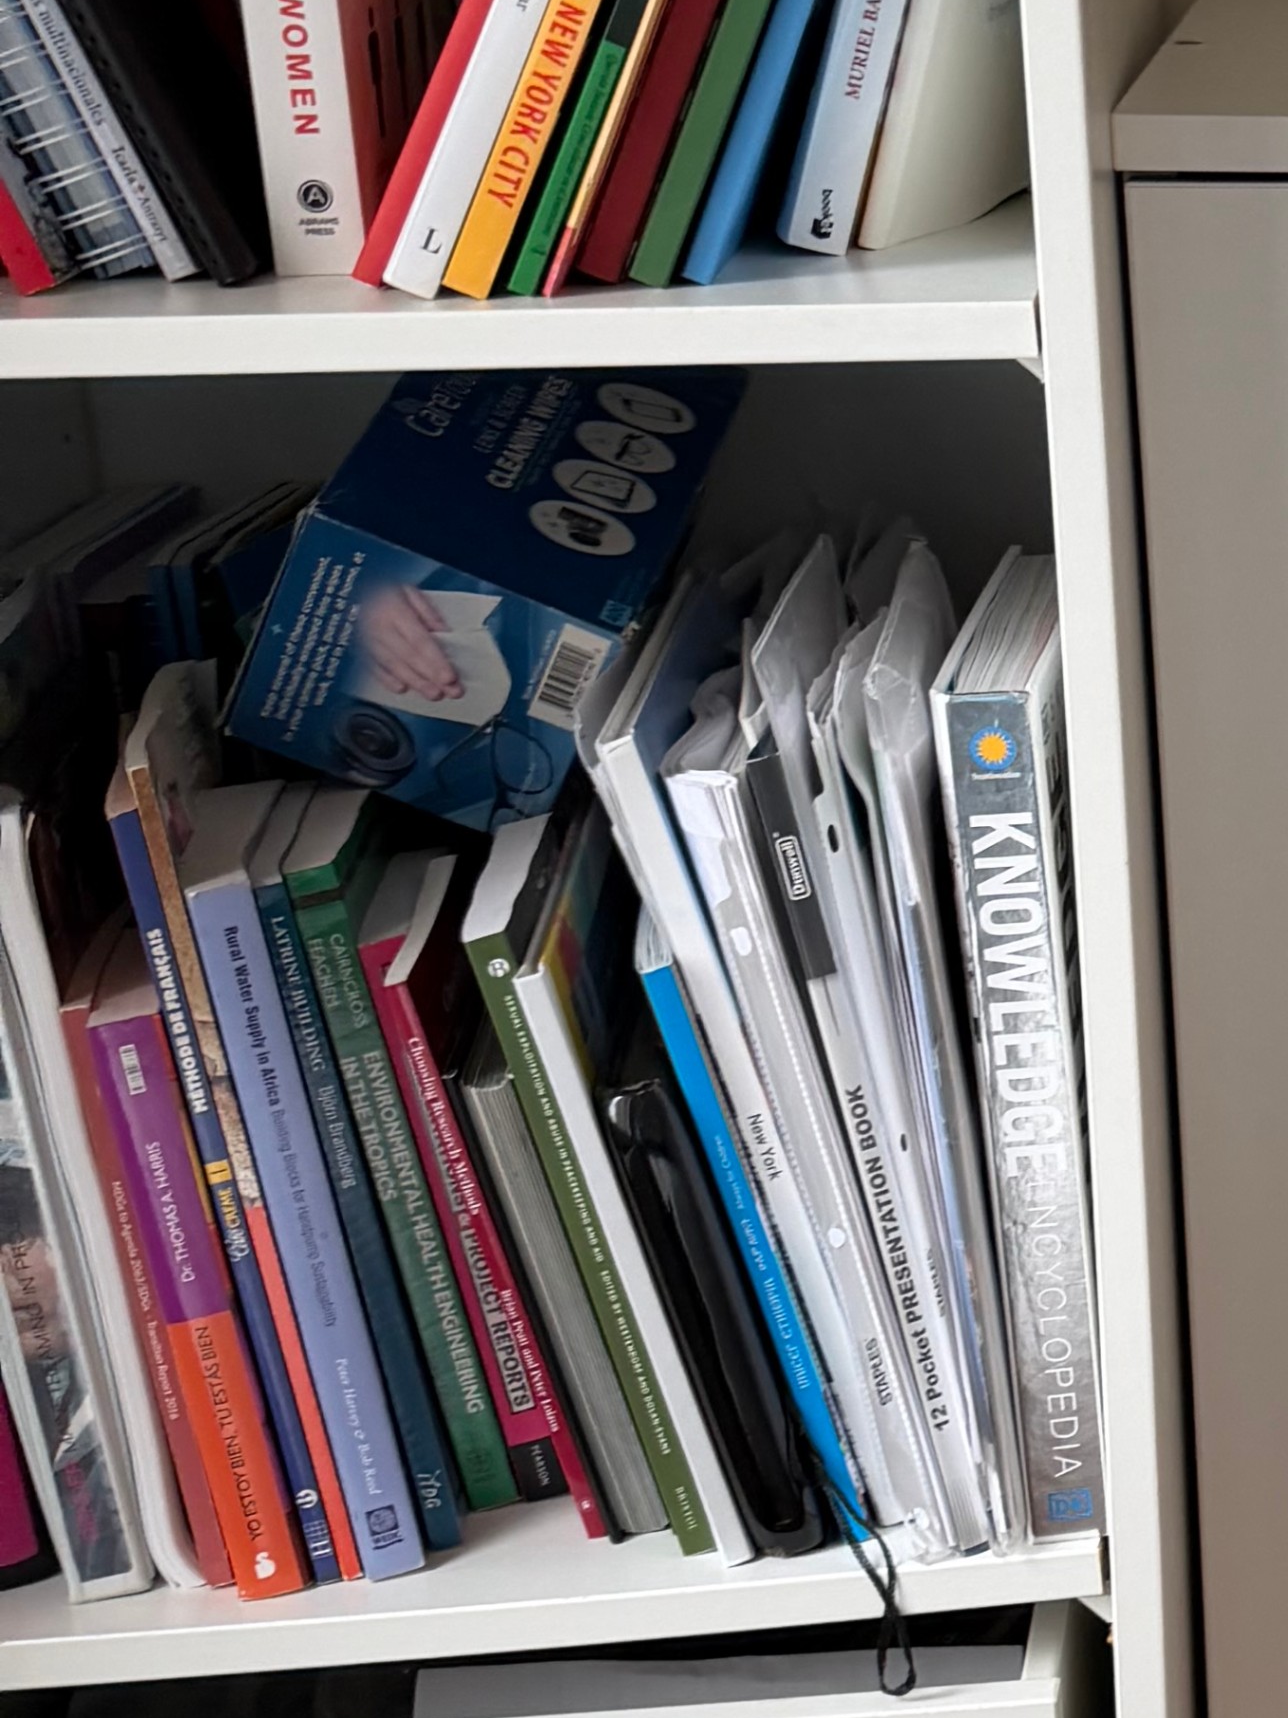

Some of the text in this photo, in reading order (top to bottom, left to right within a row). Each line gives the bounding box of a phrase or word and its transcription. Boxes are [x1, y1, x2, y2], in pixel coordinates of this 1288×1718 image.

[540, 0, 585, 67] NEW
[38, 10, 104, 126] multinacionales
[844, 27, 875, 99] MURIEL
[509, 70, 558, 143] YORK
[487, 145, 530, 208] CITY
[420, 227, 443, 254] L
[223, 925, 245, 961] Rural
[146, 928, 180, 1010] FRANÇAIS
[233, 963, 253, 1002] Water
[328, 933, 370, 1029] CAIRNCROSS
[270, 915, 325, 1071] LATRINE BUILDING
[503, 994, 522, 1029] SEXUAL
[168, 1010, 187, 1034] DE
[244, 1005, 266, 1048] Supply
[255, 1050, 270, 1065] in
[516, 1030, 545, 1095] EXPLOITATION
[260, 1067, 280, 1106] Africa
[539, 1096, 553, 1116] AND
[270, 1108, 291, 1153] Building
[316, 1084, 356, 1189] Björn Brandberg
[339, 1055, 397, 1201] IN THE TROPICS
[407, 1036, 438, 1100] Choosing
[430, 1100, 462, 1159] Research
[453, 1160, 481, 1215] Methods
[547, 1118, 564, 1146] ABUSE
[745, 1112, 782, 1181] New York
[968, 811, 1068, 1178] KNOWLEDGE
[1022, 1174, 1083, 1480] ENCYCLOPEDIA
[144, 1141, 169, 1189] HARRIS
[282, 1152, 301, 1188] Blocks
[558, 1147, 568, 1159] IN
[291, 1188, 305, 1203] for
[562, 1159, 591, 1224] PEACEKEEPING
[118, 1211, 127, 1223] to
[161, 1203, 188, 1261] THOMAS
[296, 1205, 320, 1259] Handpump
[363, 1050, 422, 1213] ENVIRONMENTAL
[411, 1213, 447, 1290] HEALTH
[434, 1290, 484, 1413] ENGINEERING
[584, 1225, 598, 1245] AND
[120, 1223, 138, 1258] Agenda
[845, 1084, 949, 1431] 12 Pocket PRESENTATION BOOK
[19, 1276, 38, 1295] IN
[499, 1288, 518, 1319] Brian
[460, 1231, 534, 1406] PROJECT REPORTS
[599, 1269, 618, 1302] EDITED
[611, 1302, 622, 1314] BY
[636, 1375, 650, 1394] AND
[146, 1320, 164, 1364] Transition
[194, 1325, 217, 1361] BIEN
[521, 1347, 539, 1369] and
[156, 1363, 172, 1395] Report
[334, 1357, 349, 1385] Peter
[342, 1387, 359, 1426] Harvey
[529, 1368, 547, 1397] Peter
[865, 1337, 892, 1406] STAPLES
[530, 1443, 549, 1486] PEARSON
[231, 1470, 258, 1517] ESTOY
[245, 1517, 263, 1541] YO
